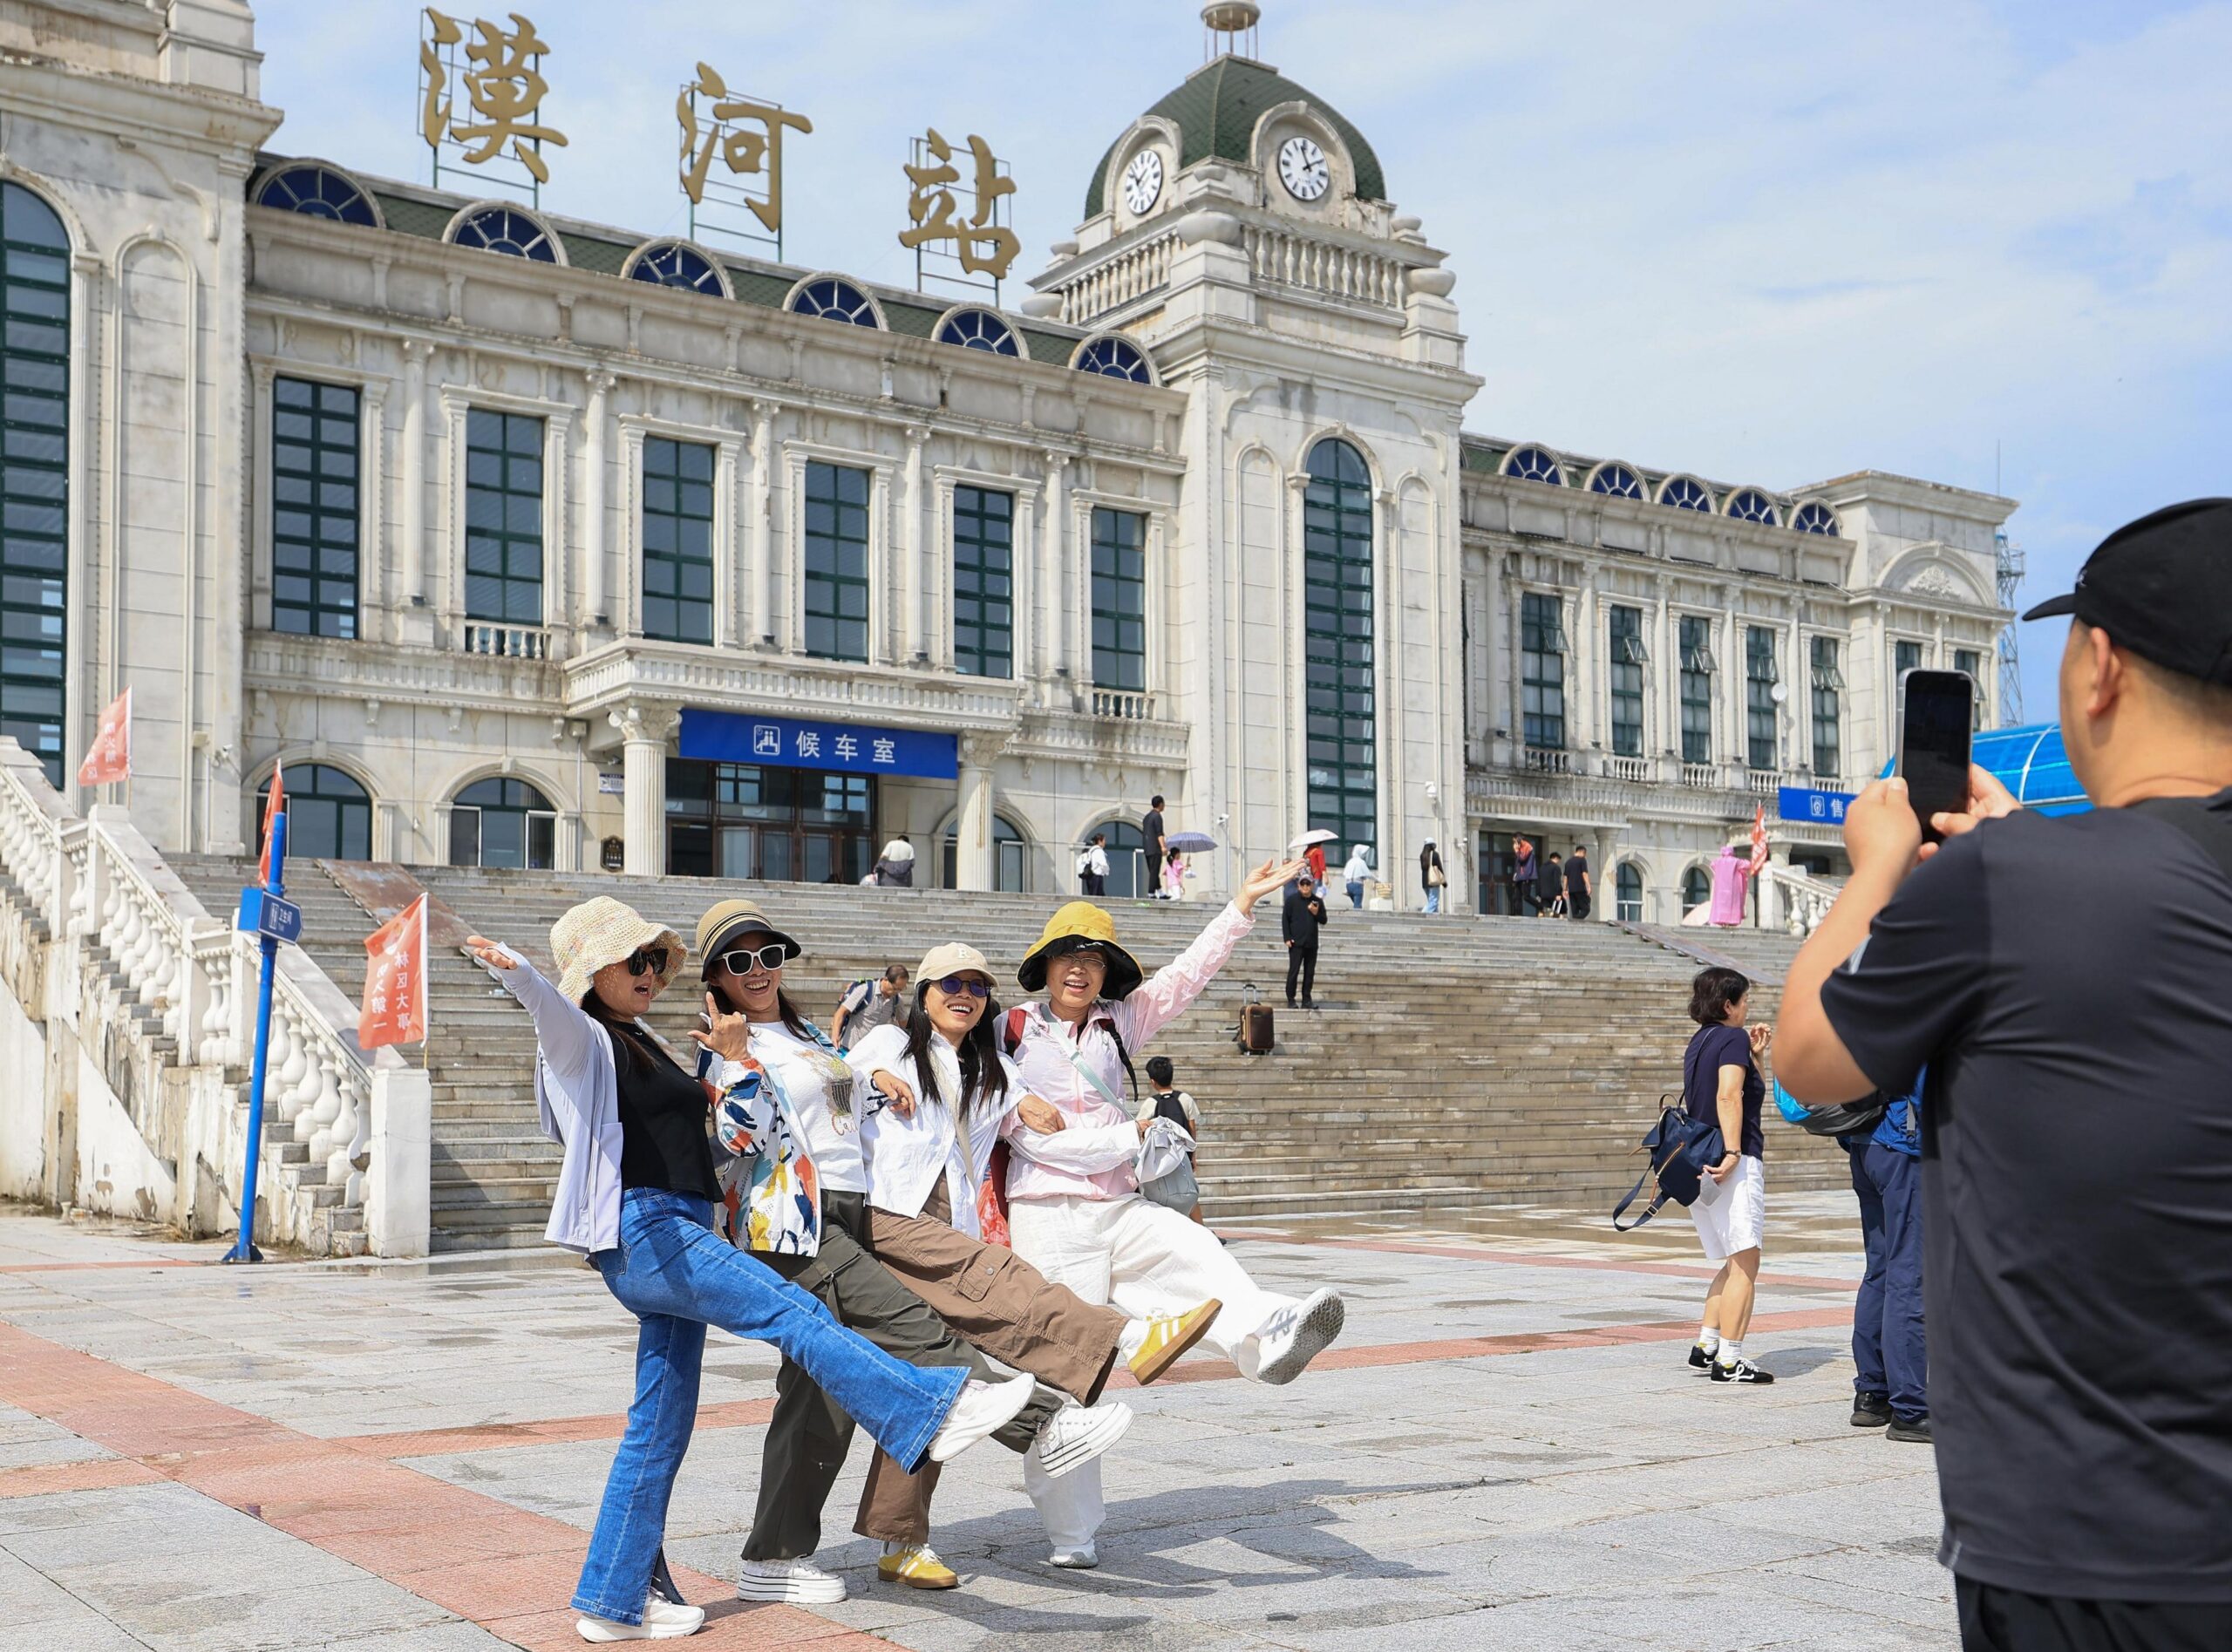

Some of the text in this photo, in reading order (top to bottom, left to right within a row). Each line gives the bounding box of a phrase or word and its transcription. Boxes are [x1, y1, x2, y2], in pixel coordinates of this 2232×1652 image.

[421, 7, 1022, 279] 漠河站
[796, 731, 895, 764] 候车室
[1831, 799, 1843, 818] 售
